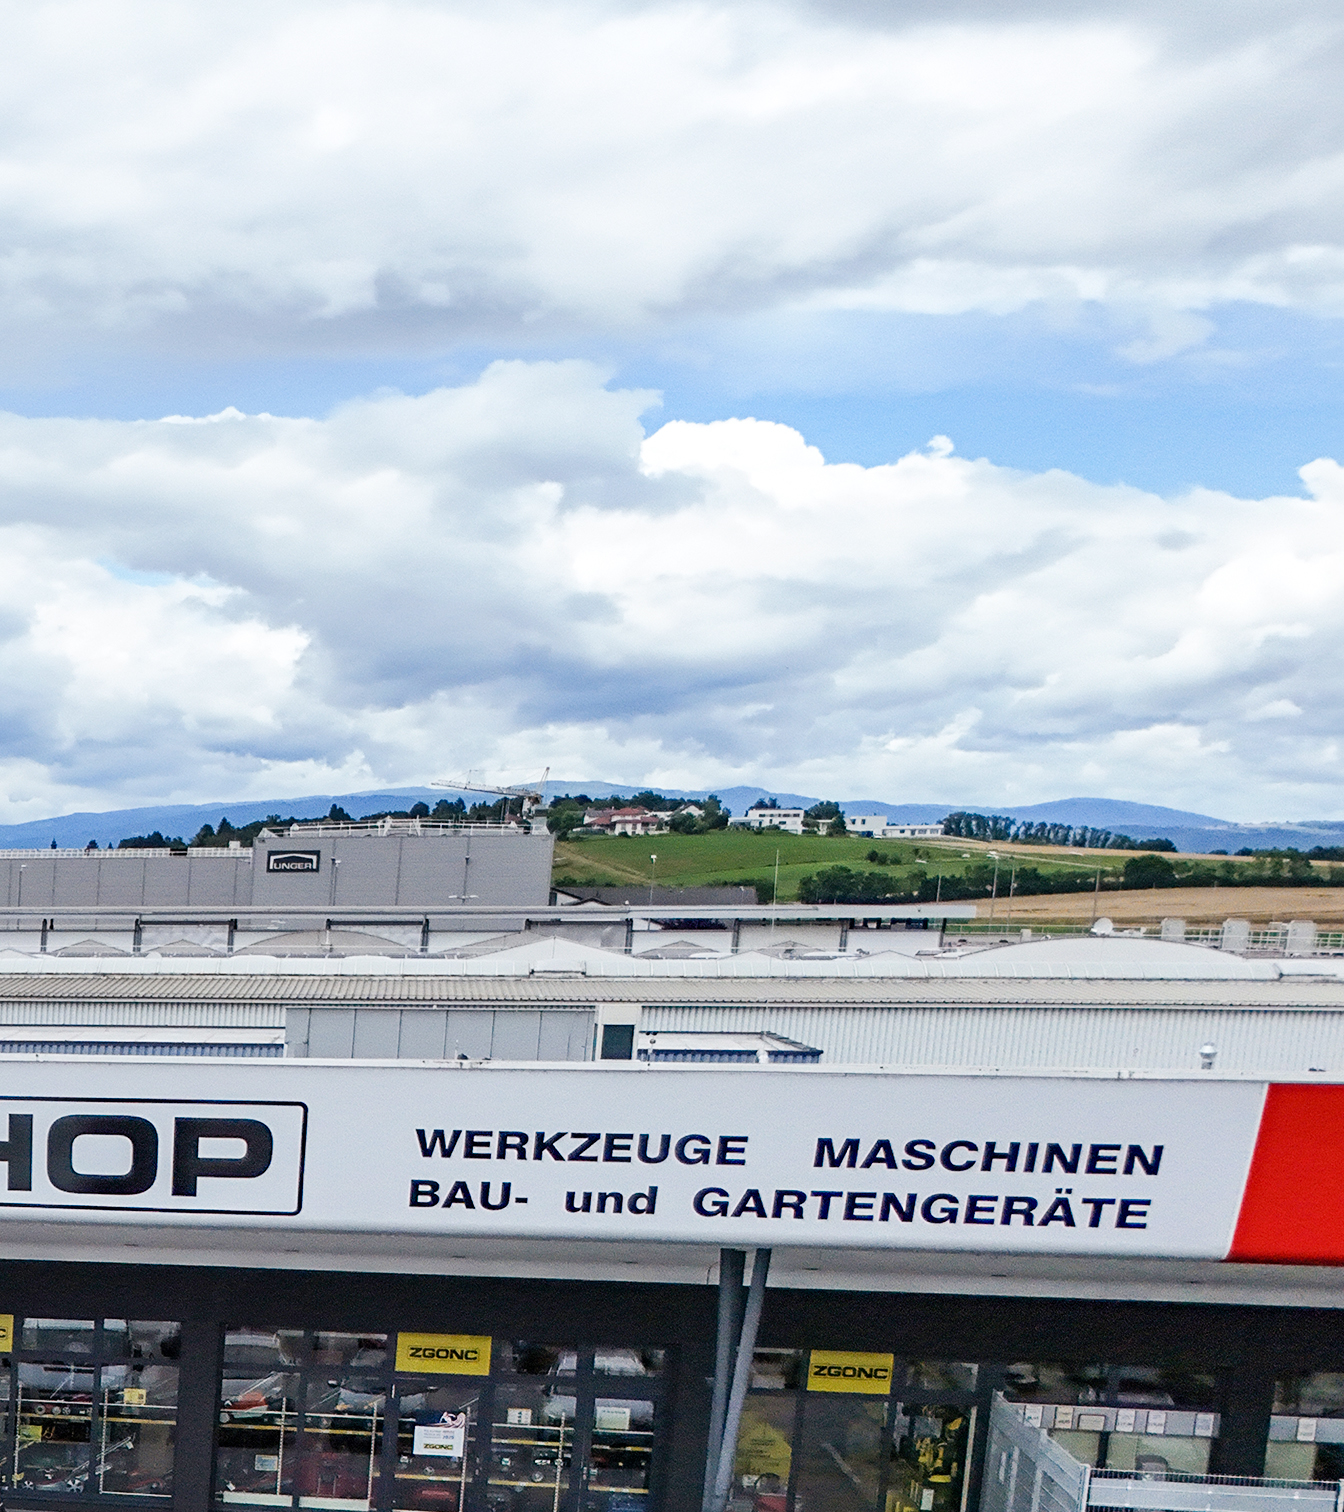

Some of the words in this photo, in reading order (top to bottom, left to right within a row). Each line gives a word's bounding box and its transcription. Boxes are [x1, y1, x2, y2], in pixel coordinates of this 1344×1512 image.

[272, 862, 313, 870] UNGER
[414, 1127, 750, 1167] WERKZEUGE
[812, 1136, 1164, 1177] MASCHINEN
[408, 1179, 529, 1211] BAU-
[564, 1185, 657, 1215] und
[691, 1185, 1152, 1230] GARTENGERÄTE
[409, 1346, 479, 1361] ZGONC
[812, 1365, 889, 1380] ZGONC
